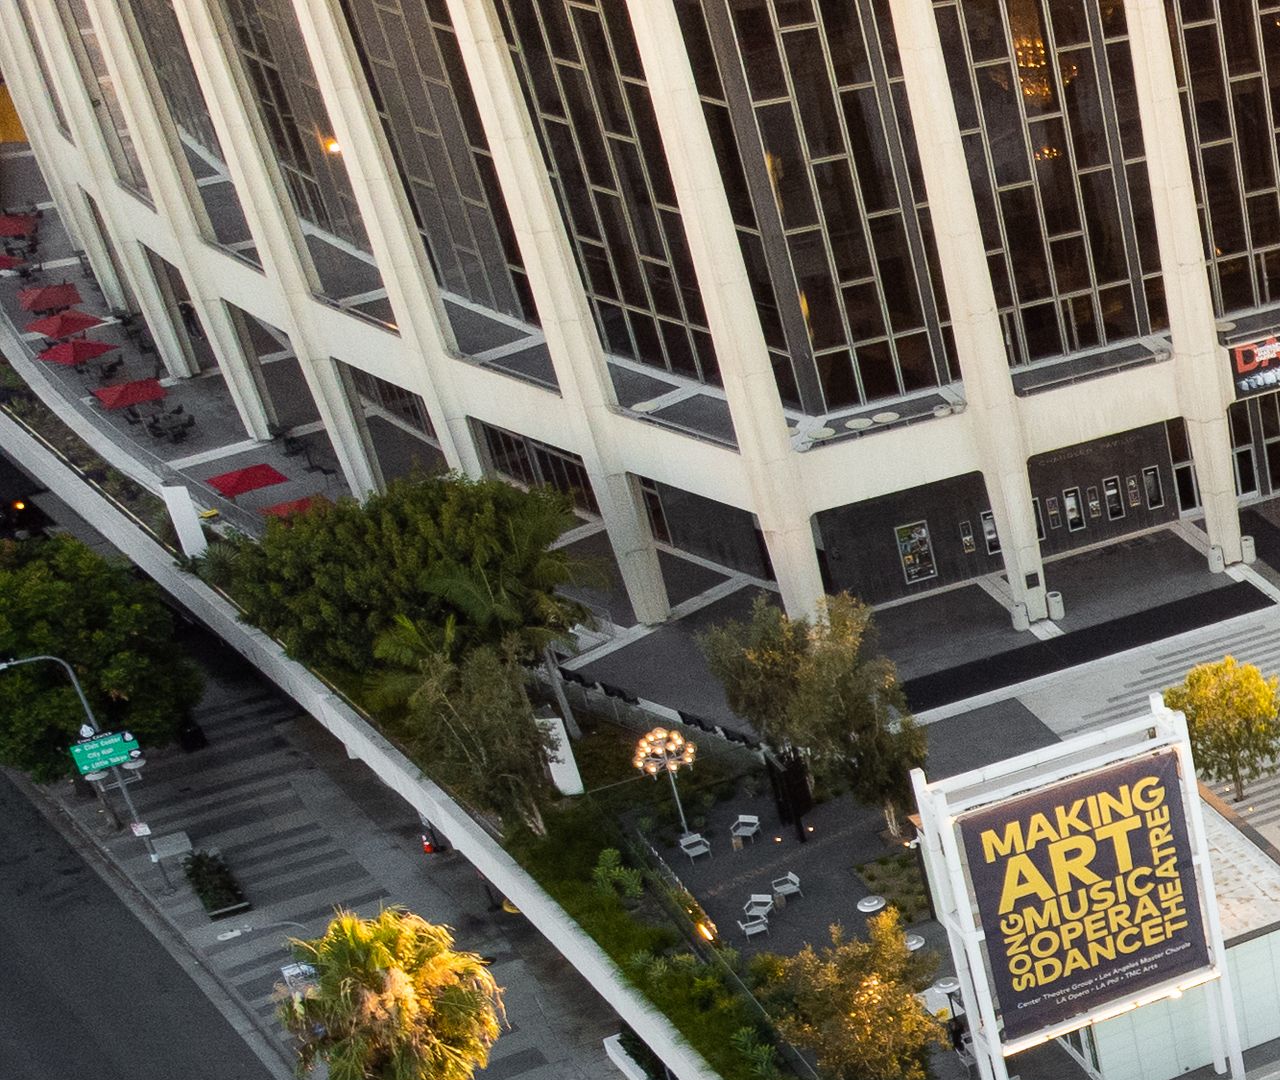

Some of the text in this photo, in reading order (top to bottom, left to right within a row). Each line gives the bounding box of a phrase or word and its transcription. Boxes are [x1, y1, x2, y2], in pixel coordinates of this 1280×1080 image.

[980, 776, 1166, 864] MAKING
[998, 815, 1142, 915] ART
[1145, 805, 1188, 939] THEATRE
[1024, 867, 1155, 935] MUSIC
[1030, 898, 1161, 958] OPERA
[1000, 913, 1037, 992] SONG
[1017, 942, 1191, 1009] Center Theatre Group Los Angeles Master Chorale
[1034, 924, 1165, 986] DANCE
[1056, 997, 1067, 1005] LA
[1068, 989, 1090, 1002] Opera
[1096, 982, 1106, 991] LA
[1125, 969, 1142, 979] TMC
[1143, 963, 1158, 973] Arts
